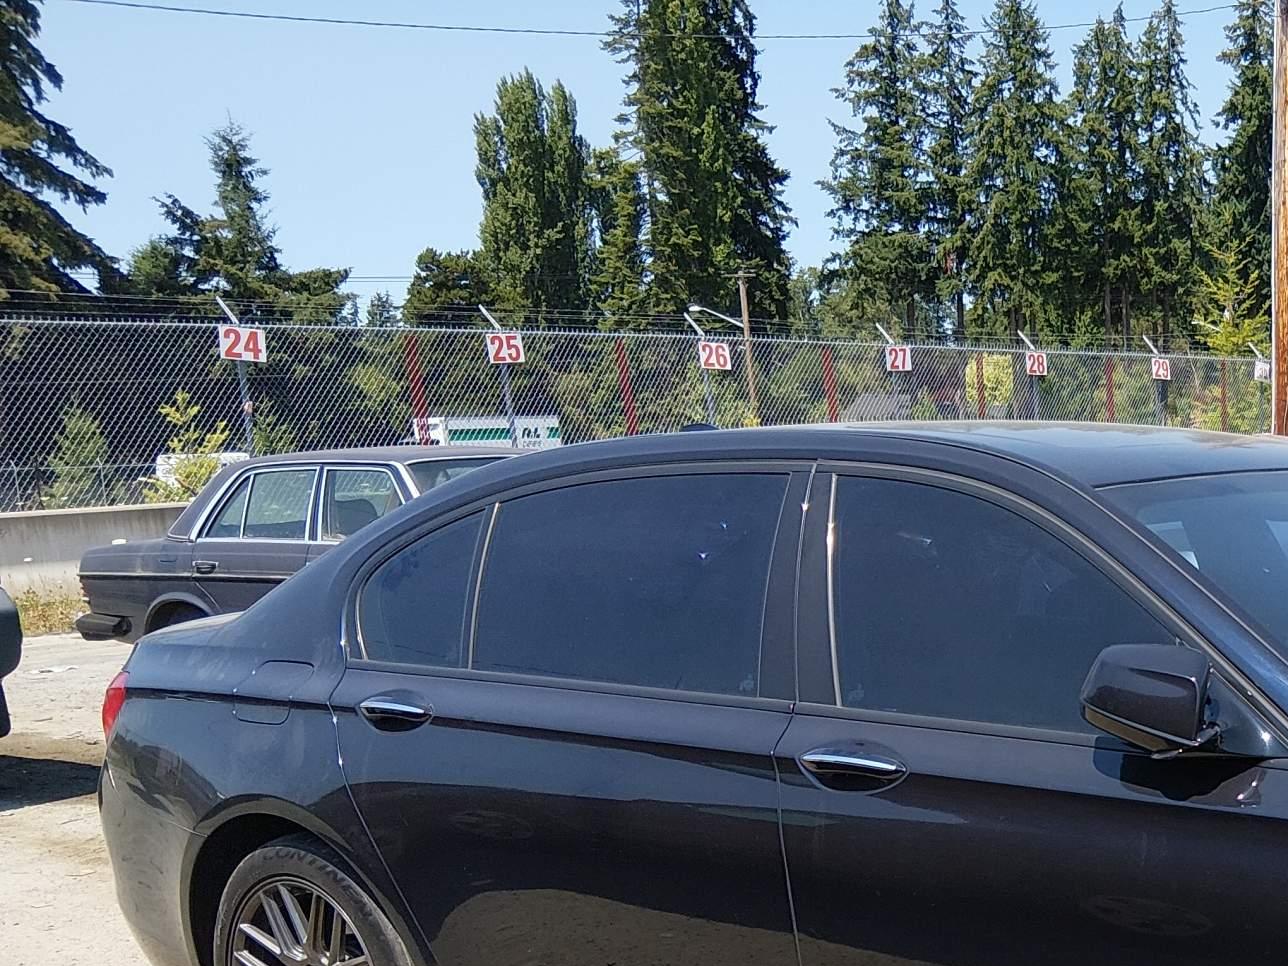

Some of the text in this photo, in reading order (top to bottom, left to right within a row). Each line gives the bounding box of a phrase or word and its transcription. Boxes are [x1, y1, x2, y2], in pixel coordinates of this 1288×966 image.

[223, 328, 262, 360] 24
[490, 335, 521, 362] 25
[702, 343, 728, 368] 26
[889, 347, 906, 370] 27
[1028, 354, 1045, 374] 28
[1154, 358, 1169, 378] 29
